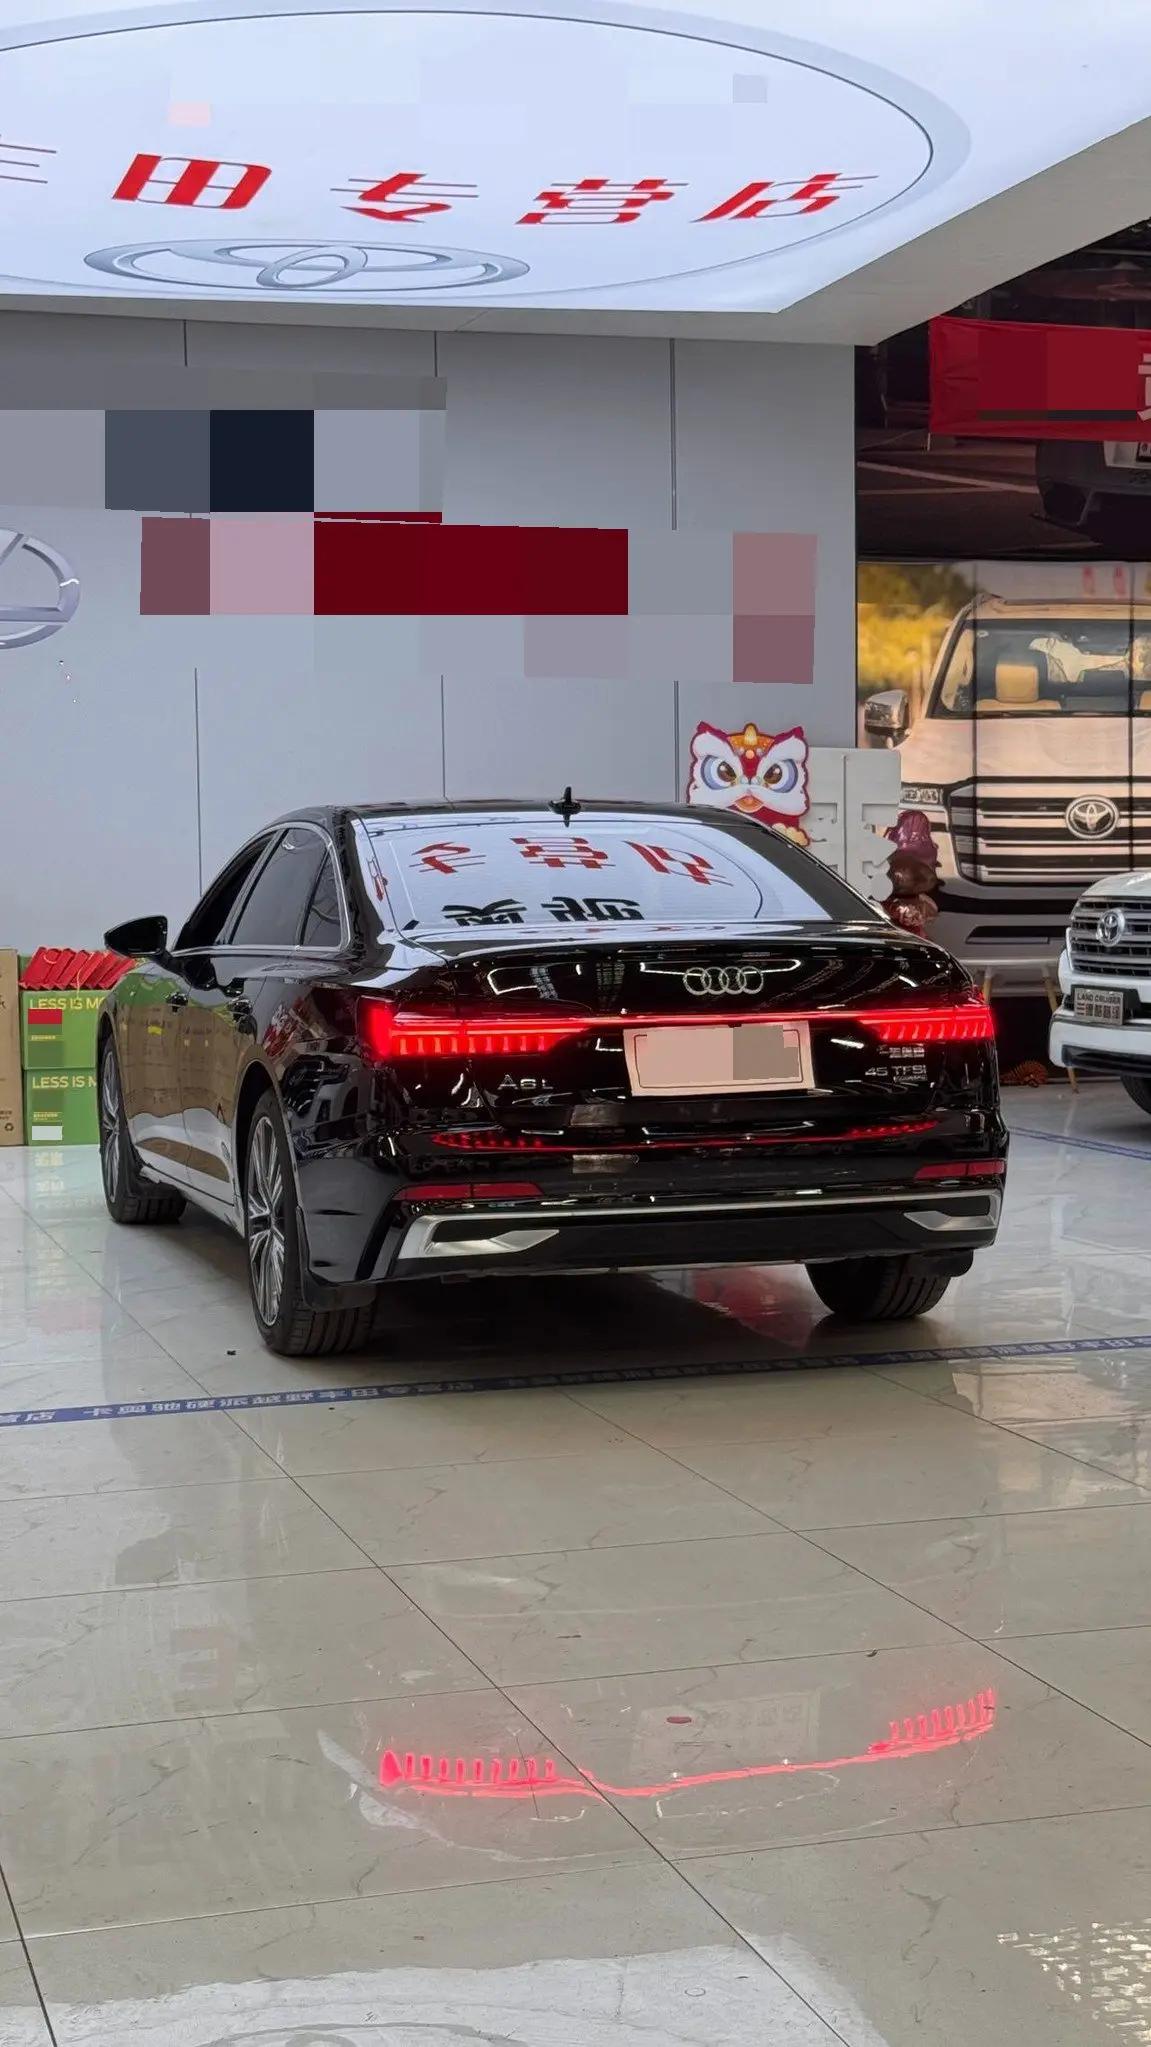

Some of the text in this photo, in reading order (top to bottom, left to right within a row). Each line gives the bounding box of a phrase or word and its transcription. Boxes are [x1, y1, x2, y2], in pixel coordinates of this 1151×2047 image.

[29, 998, 66, 1010] LESS
[70, 997, 83, 1010] IS
[864, 1066, 888, 1076] 45
[32, 1076, 69, 1089] LESS
[72, 1076, 85, 1088] IS
[497, 1074, 554, 1090] A6L
